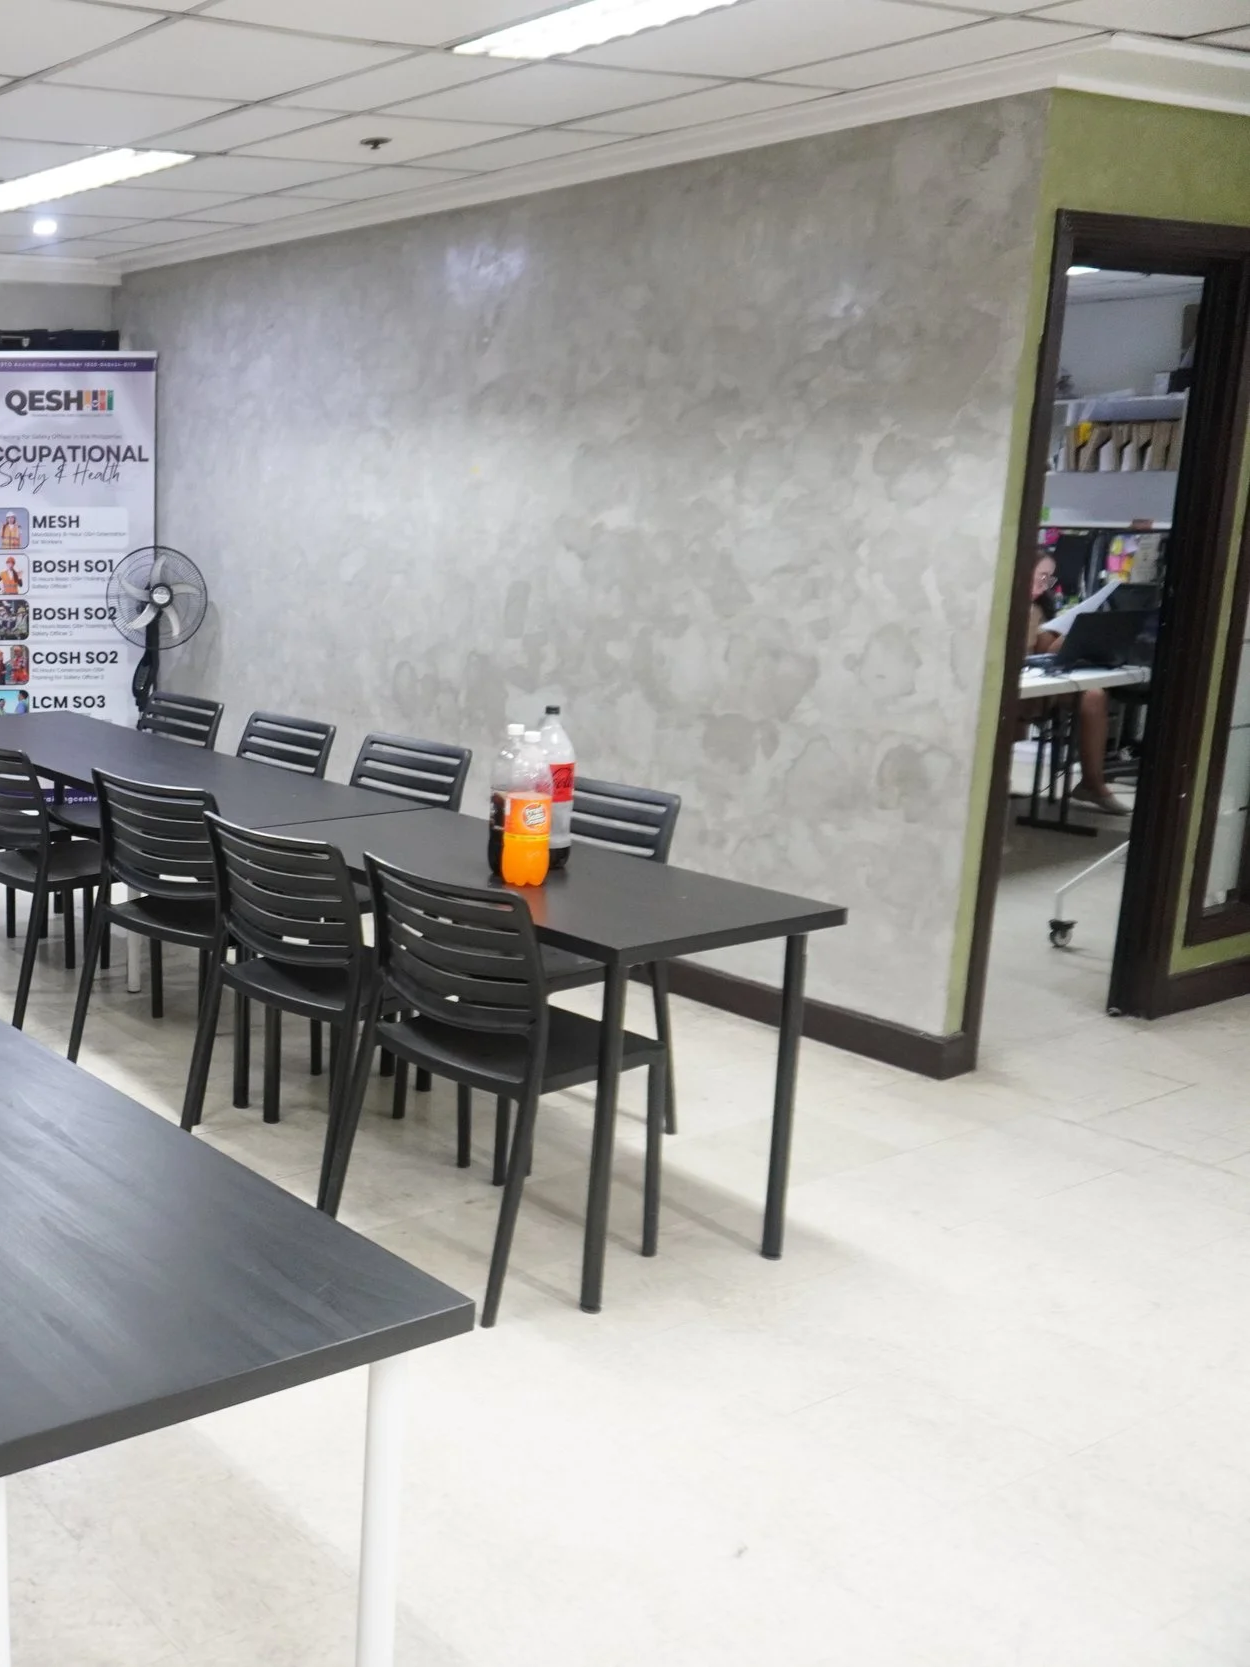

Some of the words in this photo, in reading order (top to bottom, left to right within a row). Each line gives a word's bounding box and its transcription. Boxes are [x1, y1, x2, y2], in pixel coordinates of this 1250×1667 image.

[5, 389, 83, 416] QESH
[73, 460, 120, 486] Health
[32, 515, 80, 529] MESH
[32, 560, 80, 573] BOSH
[84, 559, 113, 573] SO1
[32, 608, 80, 621] BOSH
[84, 607, 117, 621] SO2
[32, 652, 81, 665] COSH
[85, 651, 118, 665] SO2
[32, 696, 68, 709] LCM
[73, 695, 106, 709] SO3
